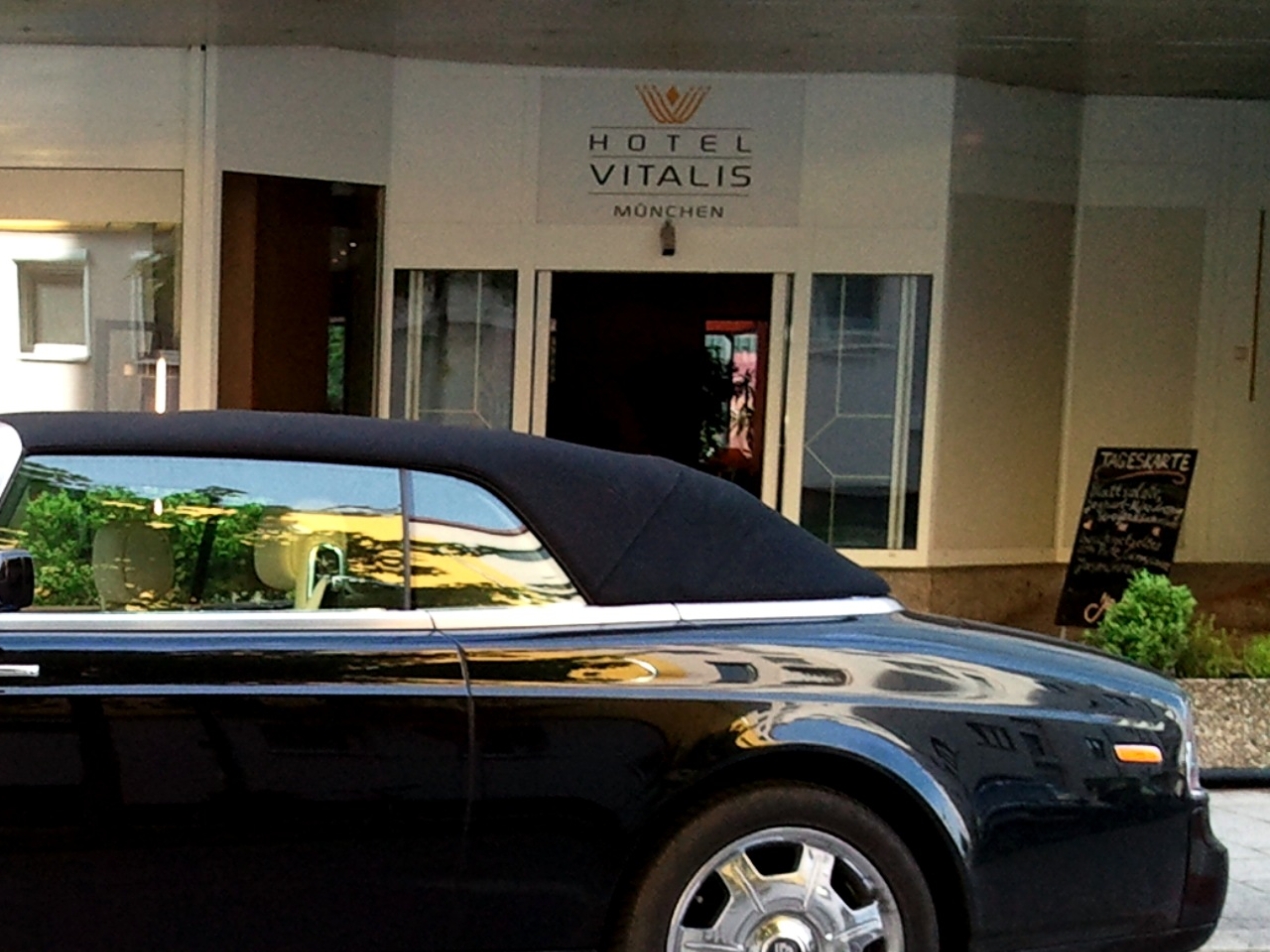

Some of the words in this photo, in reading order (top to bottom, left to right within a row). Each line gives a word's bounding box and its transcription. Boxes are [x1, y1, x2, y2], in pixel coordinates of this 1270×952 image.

[589, 133, 752, 153] HOTEL
[590, 163, 752, 188] VITALIS
[613, 202, 725, 218] MÜNCHEN
[1099, 451, 1192, 472] TAGESKARTE
